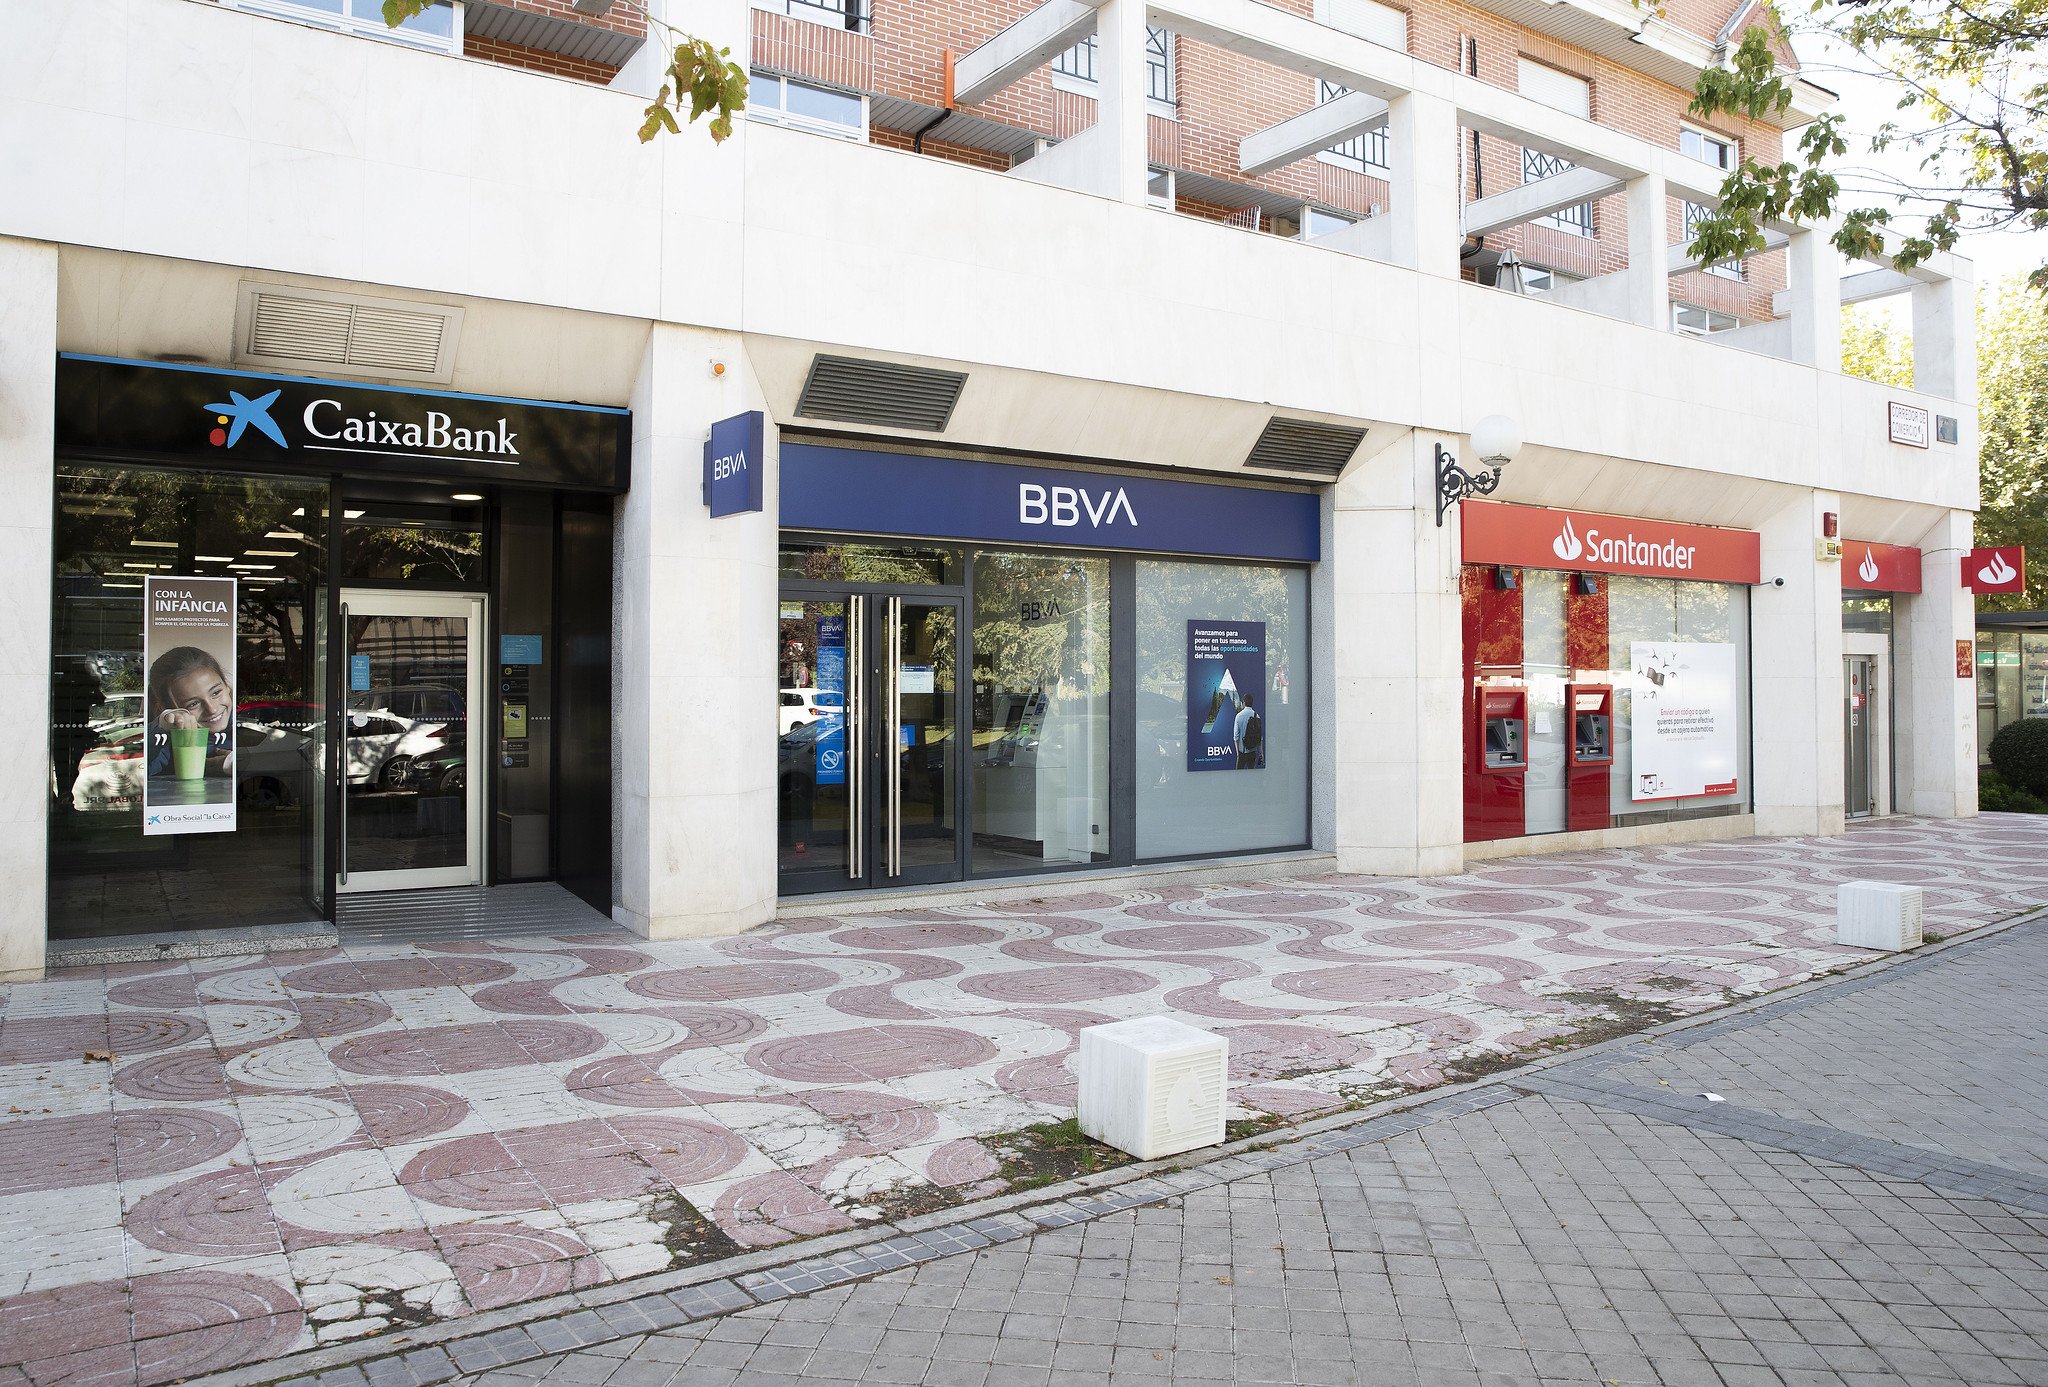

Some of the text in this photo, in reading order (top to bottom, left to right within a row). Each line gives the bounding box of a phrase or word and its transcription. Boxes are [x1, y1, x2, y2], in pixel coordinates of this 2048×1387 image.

[1892, 405, 1926, 424] CORREDOR DE
[303, 399, 520, 455] CaixaBank
[714, 449, 747, 481] BBVA
[1020, 483, 1138, 528] BBVA
[1586, 529, 1696, 569] Santander
[155, 590, 176, 598] CON
[155, 600, 228, 613] INFANCIA
[1021, 598, 1061, 620] BBVA
[1207, 746, 1232, 756] BBVA
[163, 814, 181, 822] Obra
[182, 813, 203, 821] Social
